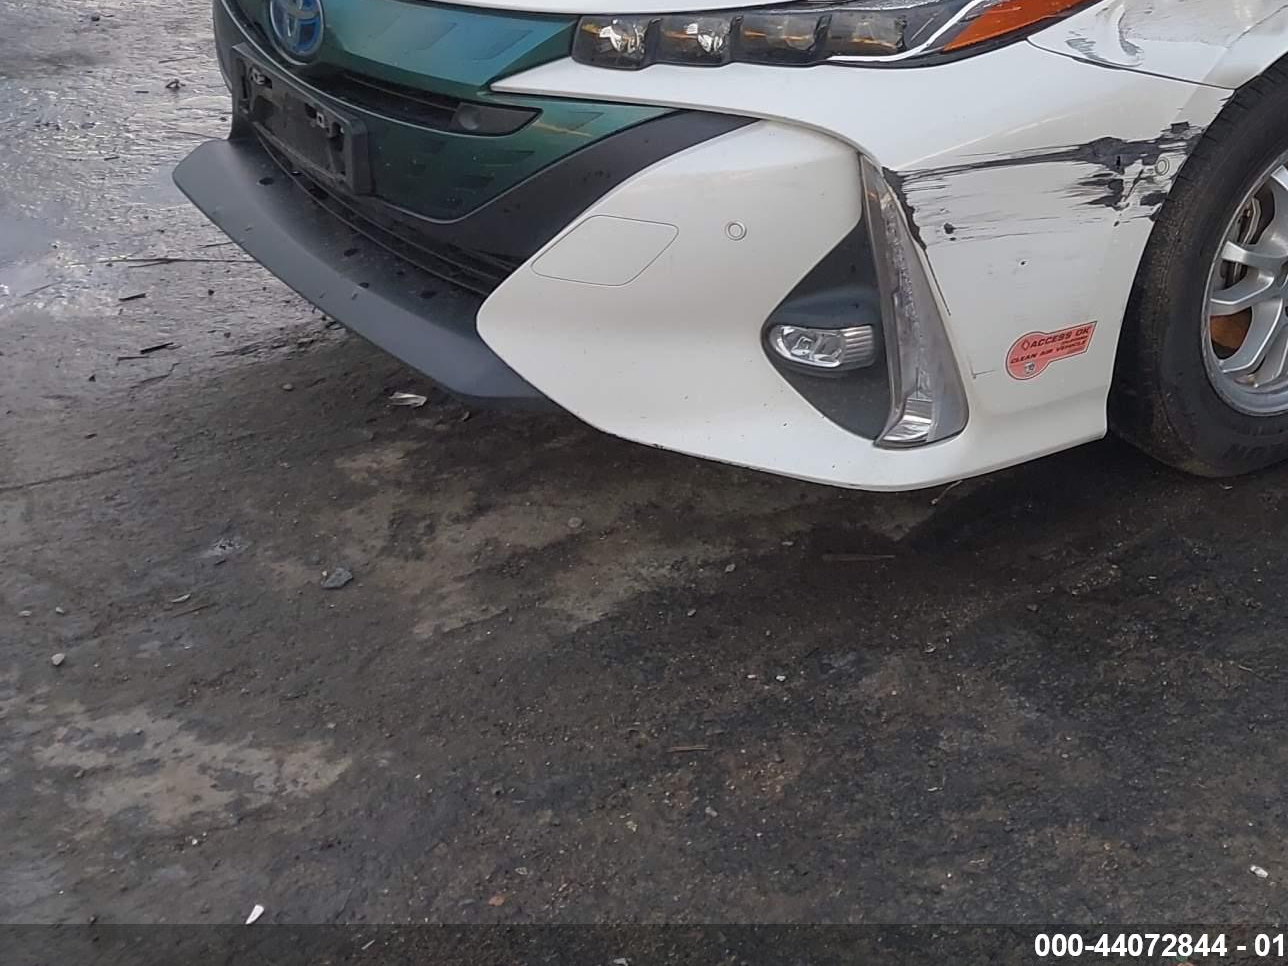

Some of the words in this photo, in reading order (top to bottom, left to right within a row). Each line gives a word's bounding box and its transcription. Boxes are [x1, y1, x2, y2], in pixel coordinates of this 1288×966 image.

[1030, 332, 1072, 348] ACCESS
[1075, 326, 1091, 337] OK
[1010, 353, 1037, 363] CLEAN
